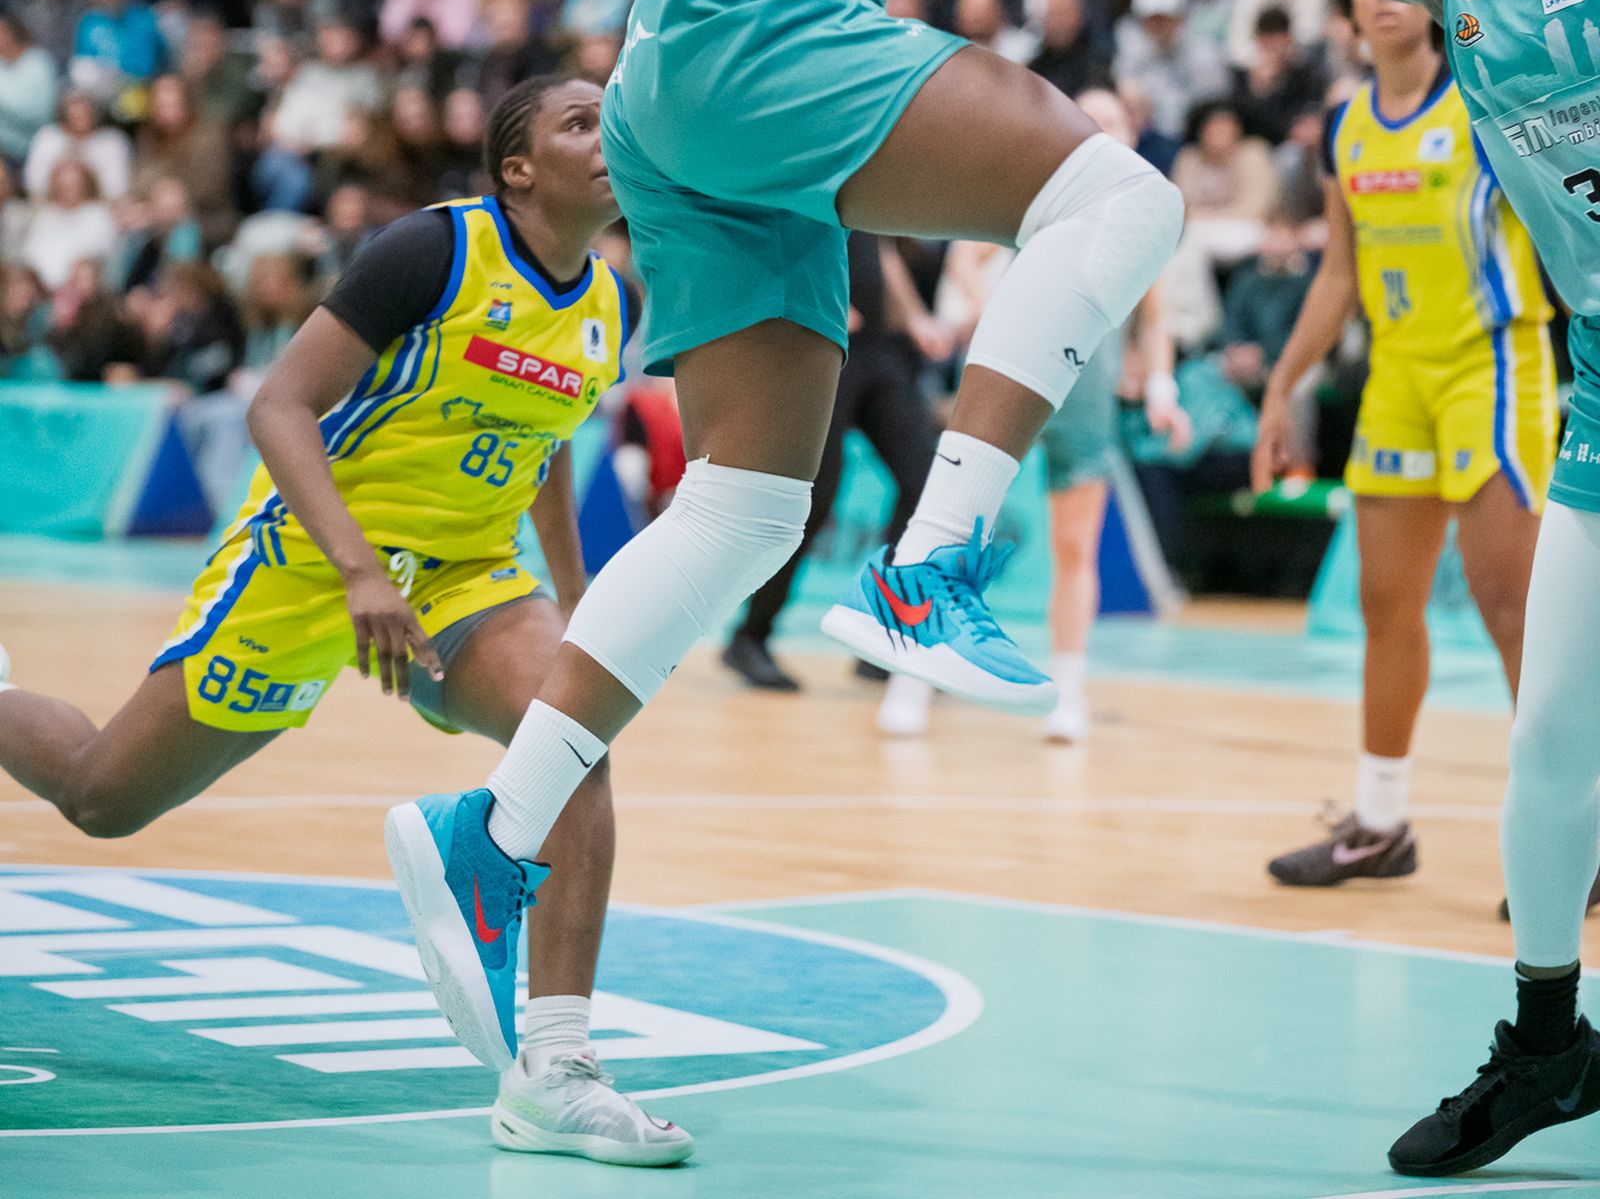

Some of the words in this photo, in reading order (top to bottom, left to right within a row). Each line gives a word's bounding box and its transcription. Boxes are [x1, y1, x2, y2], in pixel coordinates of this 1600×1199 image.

[496, 350, 583, 395] SPAR
[460, 432, 519, 488] 85
[197, 655, 270, 713] 85
